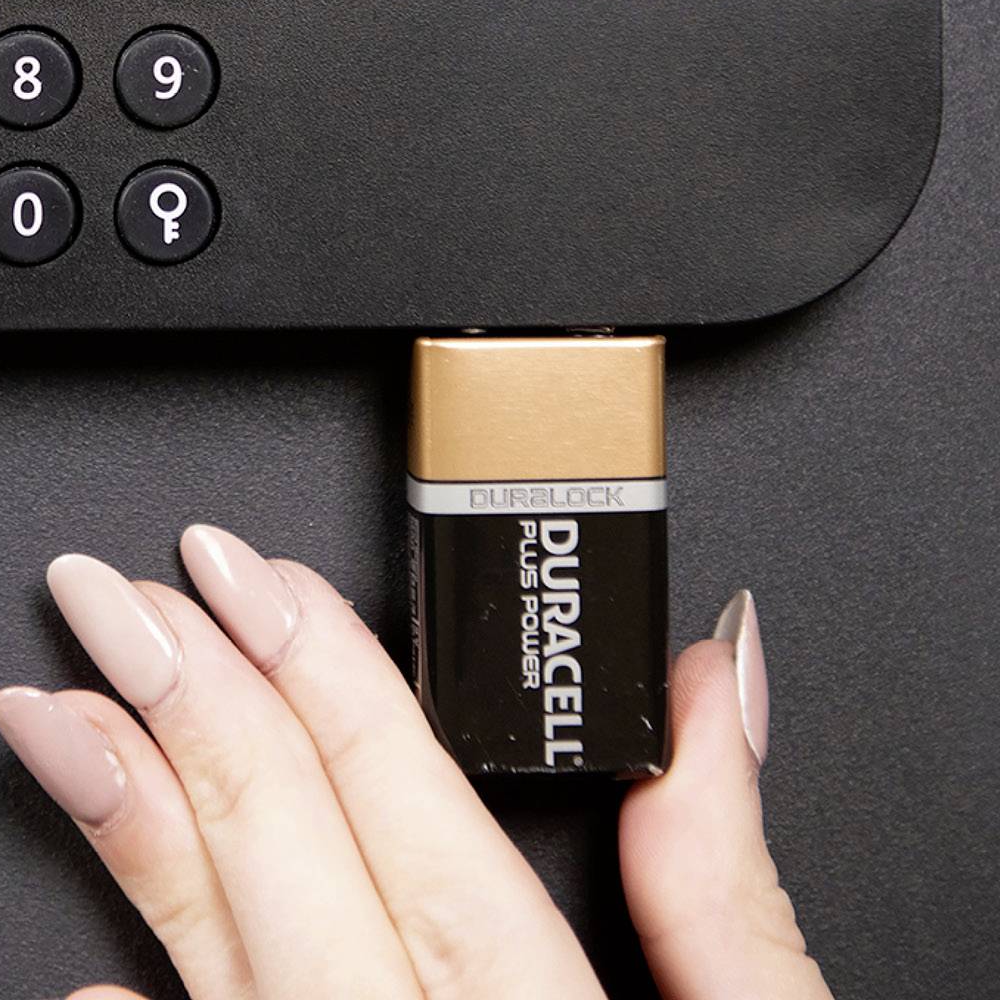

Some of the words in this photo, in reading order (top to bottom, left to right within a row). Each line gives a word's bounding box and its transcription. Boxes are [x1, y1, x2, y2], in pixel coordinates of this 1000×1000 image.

[13, 56, 42, 100] 8
[153, 56, 183, 100] 9
[13, 192, 43, 237] 0
[469, 486, 625, 509] DURALOCK
[519, 520, 538, 589] PLUS
[520, 595, 541, 690] POWER
[540, 519, 583, 767] DURACELL
